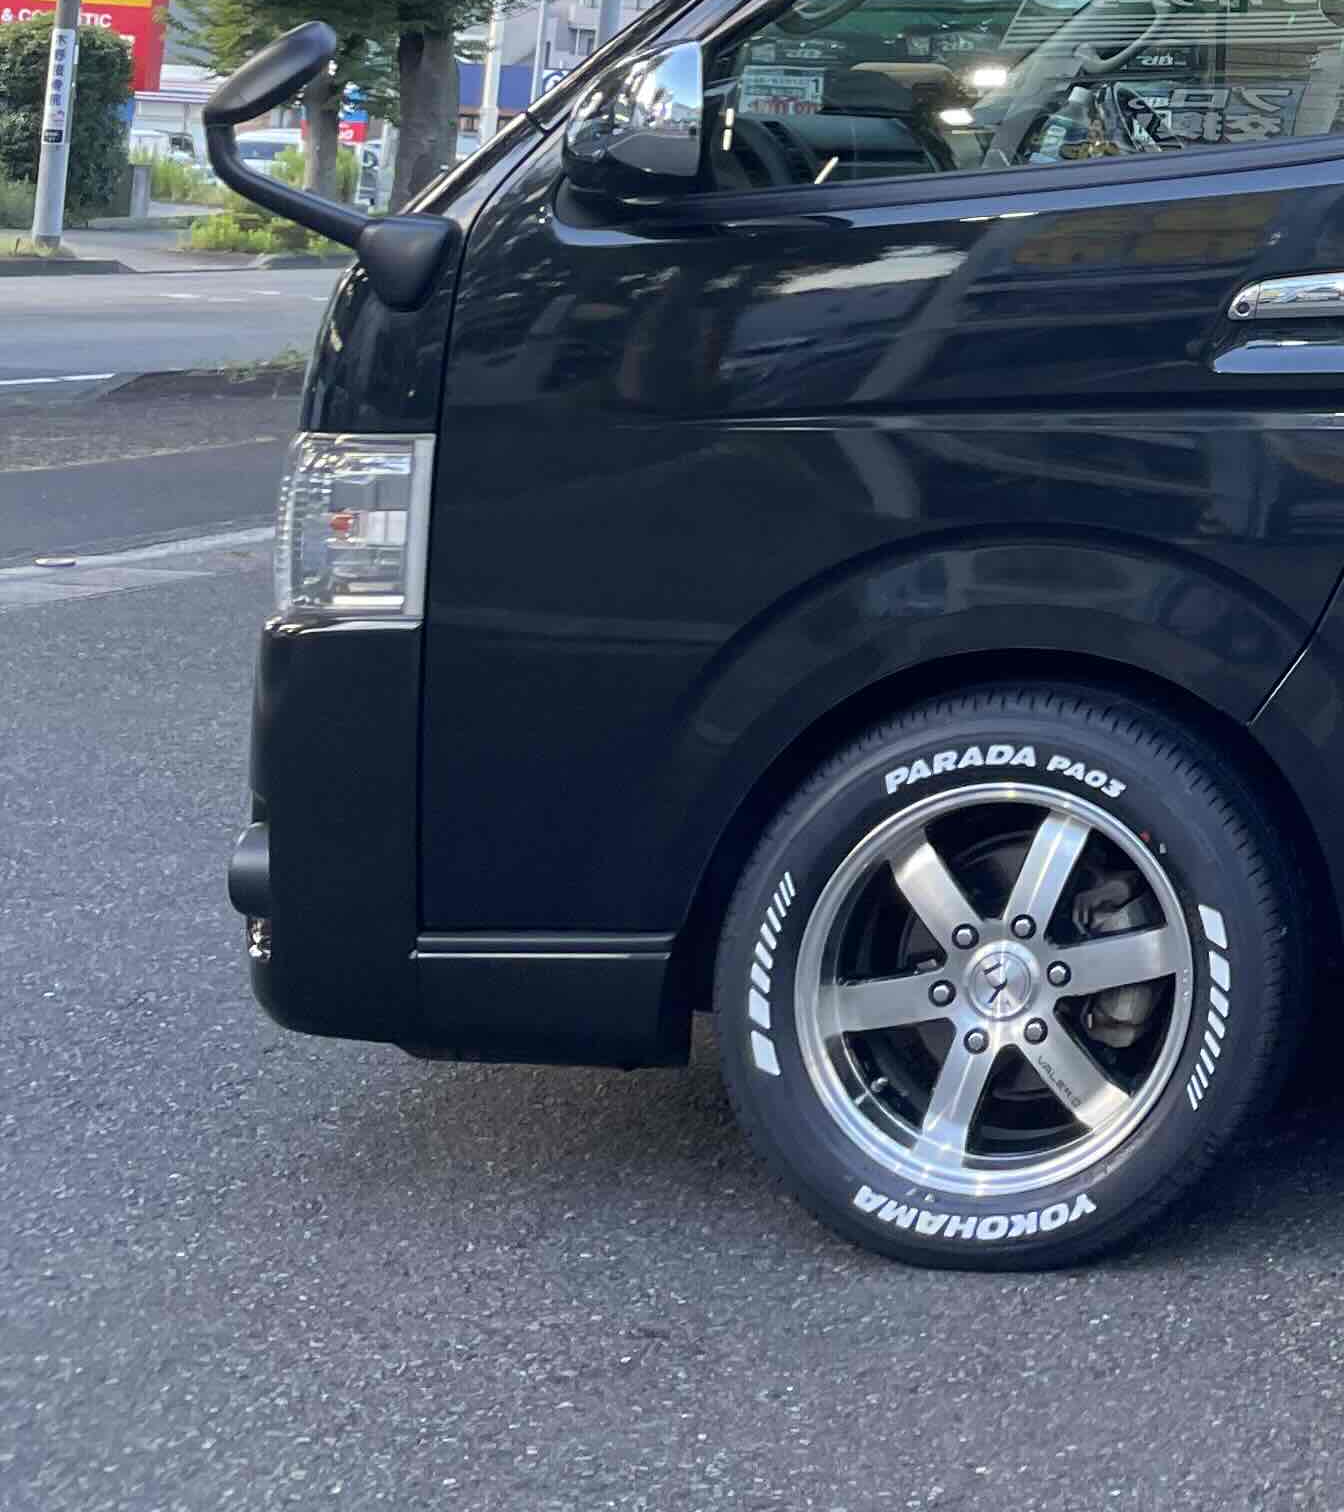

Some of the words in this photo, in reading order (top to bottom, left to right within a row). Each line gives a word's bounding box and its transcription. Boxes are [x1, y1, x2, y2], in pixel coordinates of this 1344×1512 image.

[885, 744, 1036, 794] PARADA
[1046, 754, 1127, 798] PA03
[853, 1185, 1097, 1241] YOKOHAMA
